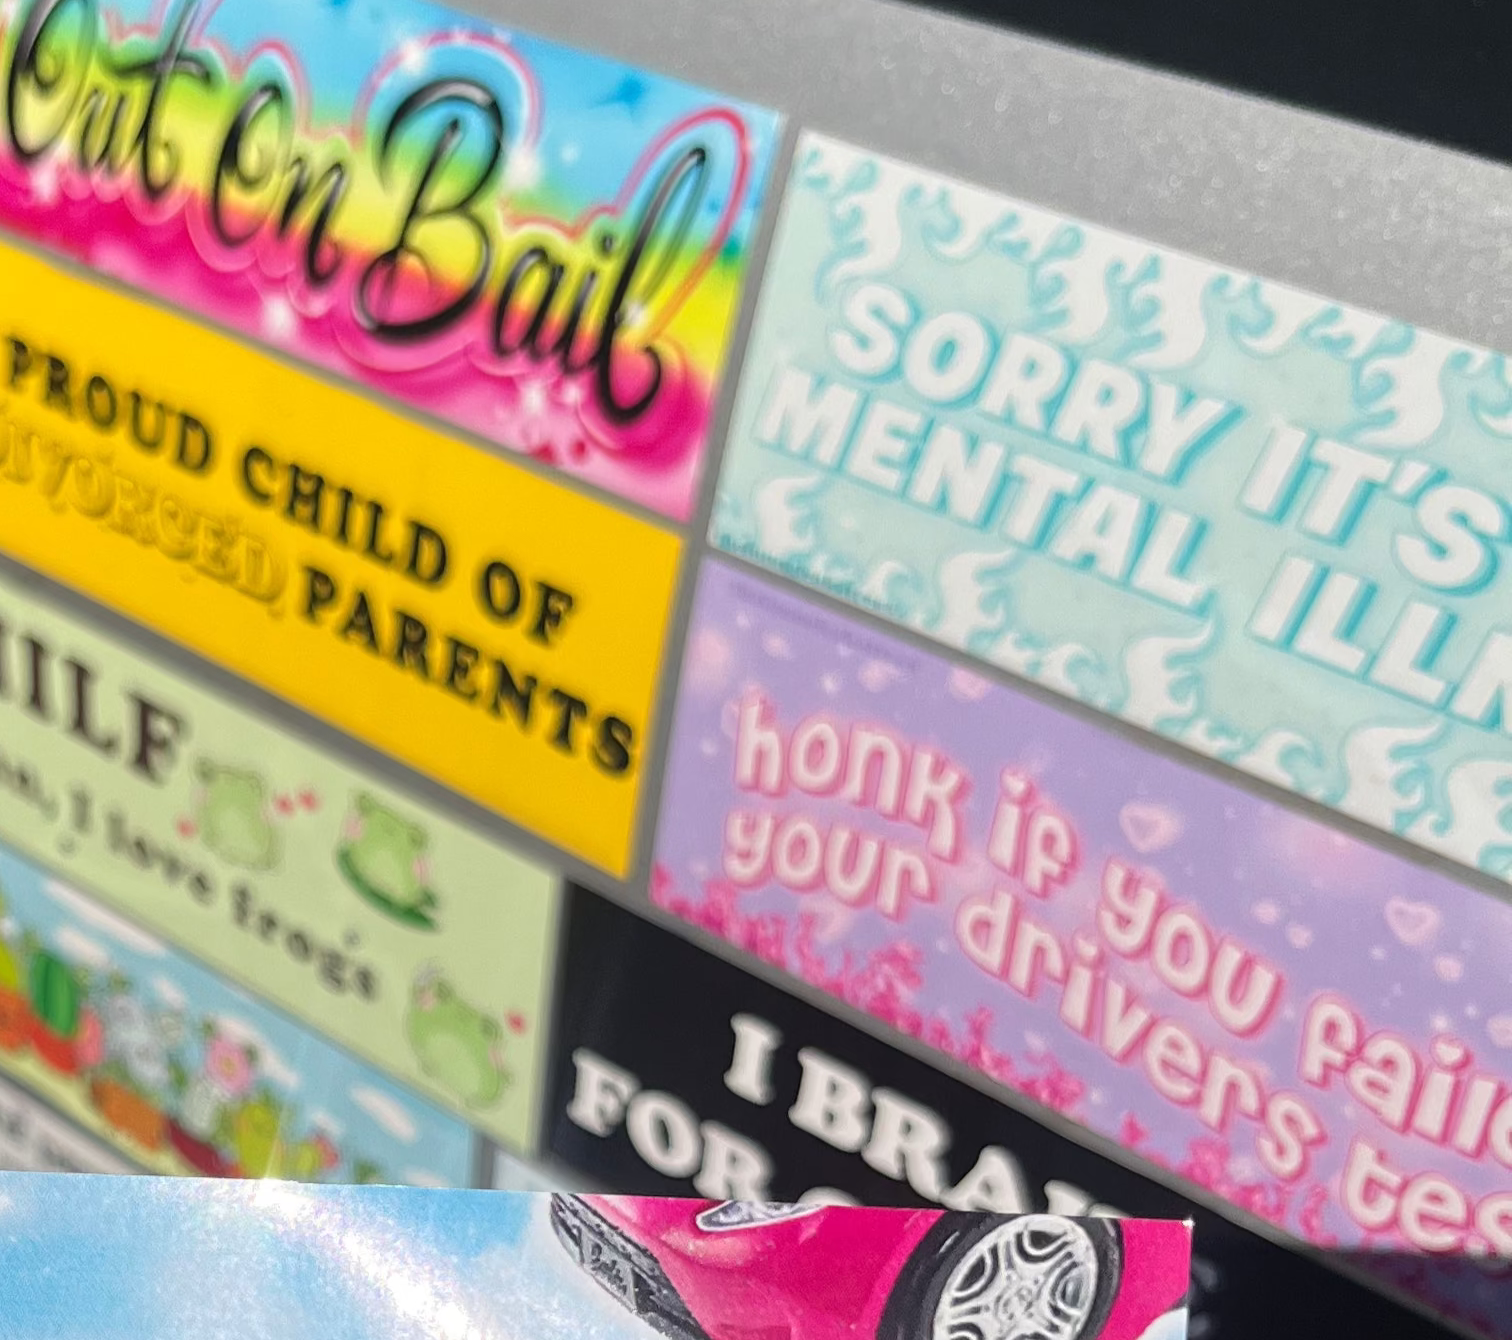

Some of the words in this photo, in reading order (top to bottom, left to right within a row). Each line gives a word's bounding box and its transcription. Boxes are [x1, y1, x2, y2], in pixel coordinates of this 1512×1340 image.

[8, 0, 213, 200] Out
[213, 80, 347, 288] On
[352, 78, 706, 427] Bail
[3, 336, 216, 474] PROUD
[240, 442, 450, 587] CHILD
[481, 558, 578, 648] OF
[754, 366, 1214, 618] MENTAL
[831, 283, 1242, 485] SORRY
[1238, 424, 1510, 595] IT'S
[301, 563, 635, 779] PARENTS
[107, 809, 217, 904] love
[230, 879, 378, 1001] frogs
[724, 806, 938, 919] your
[955, 892, 1328, 1182] drivers
[734, 695, 974, 862] honk
[988, 768, 1079, 897] if
[1098, 856, 1283, 1036] you
[567, 1047, 774, 1203] FOR
[723, 1012, 783, 1106] I
